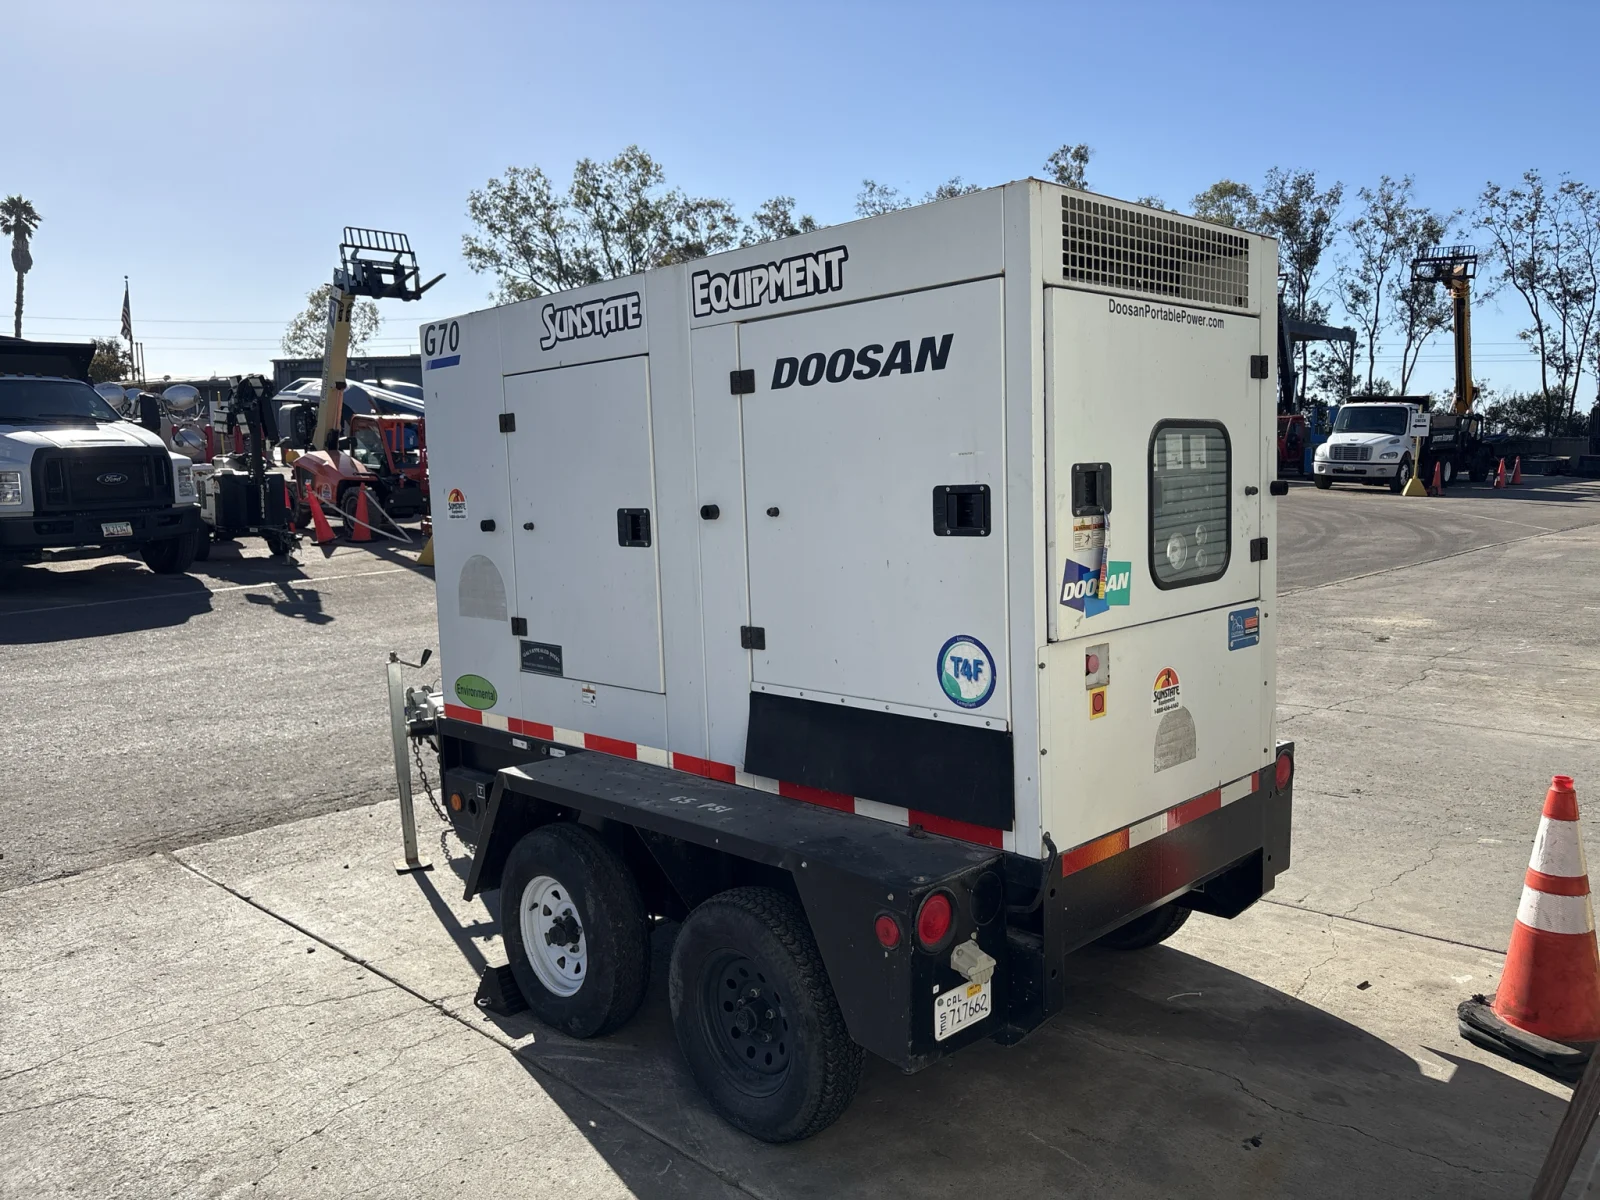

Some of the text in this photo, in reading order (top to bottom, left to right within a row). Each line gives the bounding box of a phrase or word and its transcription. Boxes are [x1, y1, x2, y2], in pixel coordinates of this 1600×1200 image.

[540, 245, 848, 351] SUNSTATE EQUIPMENT
[1108, 298, 1225, 329] DoosanPortablePower.com
[424, 321, 460, 356] G70
[771, 333, 954, 390] DOOSAN
[104, 474, 122, 483] Ford
[950, 656, 984, 681] T4F
[456, 683, 496, 701] Environmental
[1153, 685, 1180, 703] SUNSTATE
[947, 994, 962, 1007] CAL
[949, 993, 987, 1027] 717662
